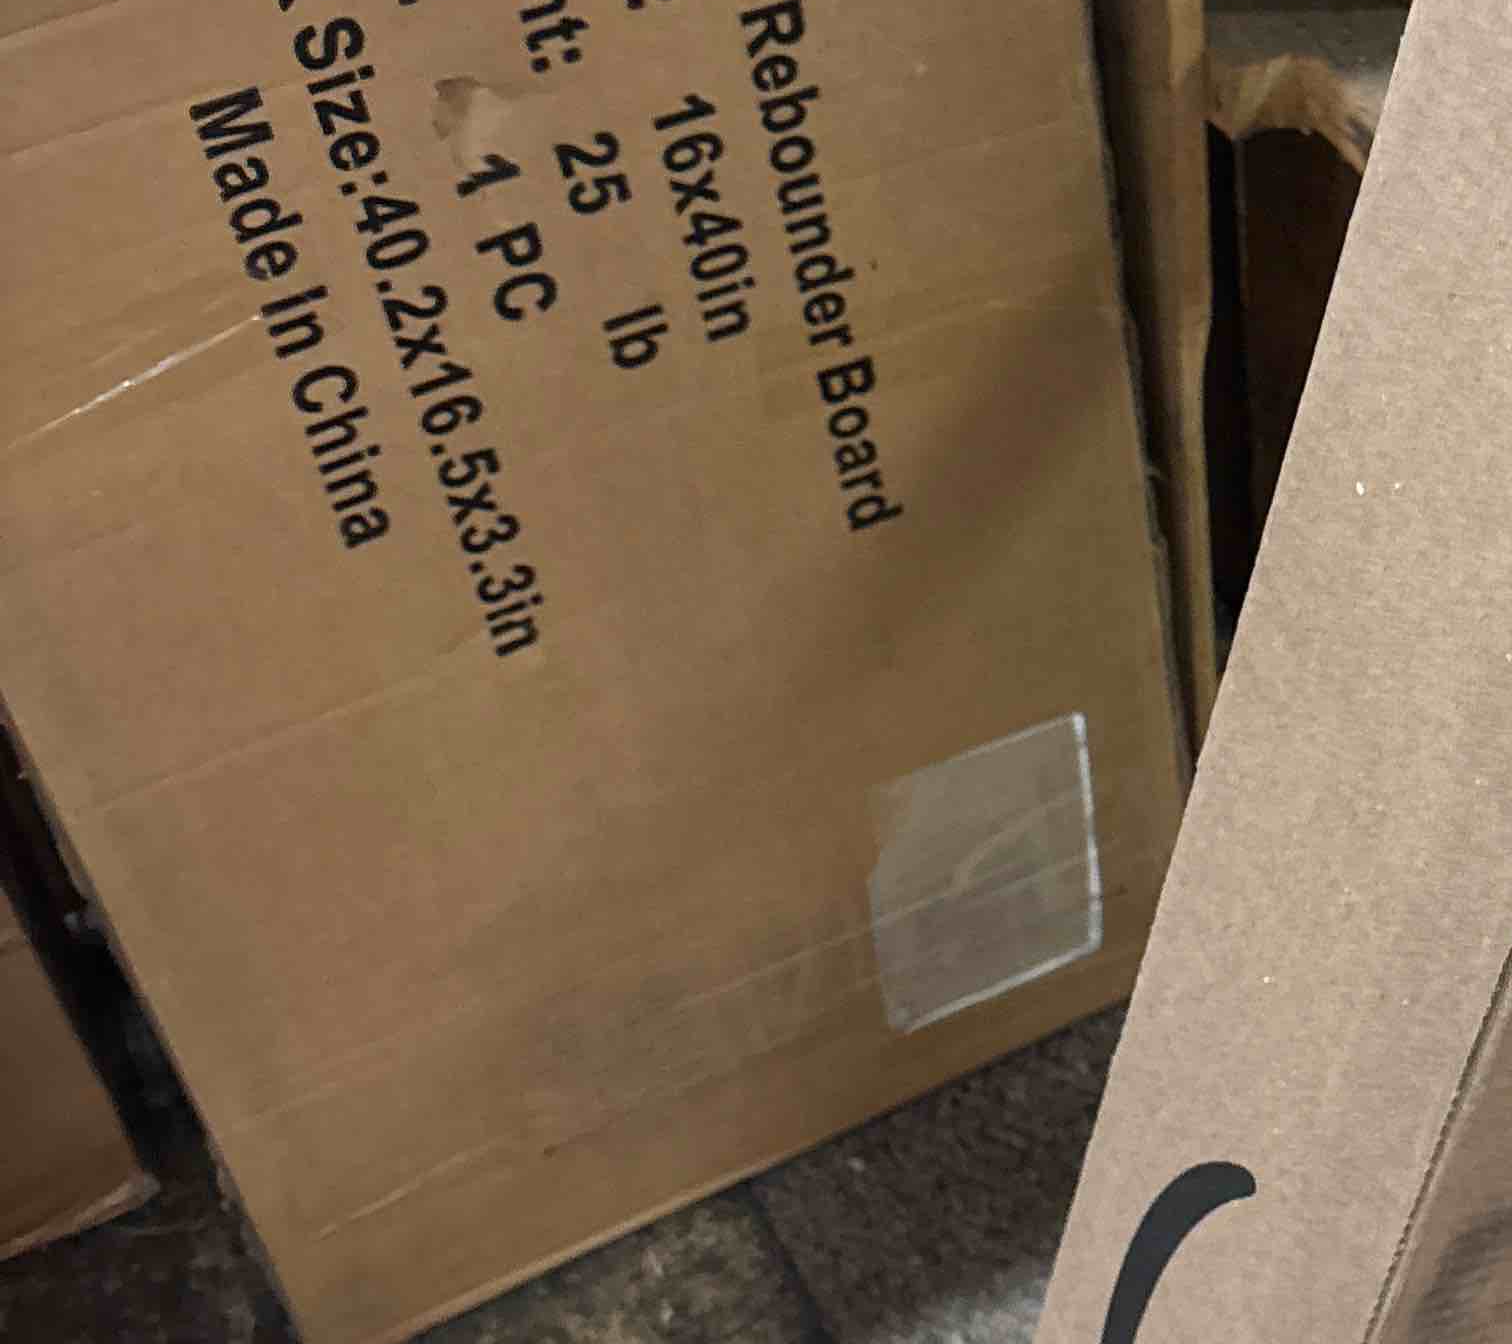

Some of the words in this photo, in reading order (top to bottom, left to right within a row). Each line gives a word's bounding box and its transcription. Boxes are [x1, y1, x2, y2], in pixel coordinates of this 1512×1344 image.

[188, 86, 303, 281] Made
[456, 153, 521, 198] 1
[553, 131, 633, 215] 25
[603, 303, 669, 369] lb
[653, 93, 756, 342] 16x40in
[260, 284, 329, 359] In
[475, 222, 558, 322] PC
[291, 365, 390, 549] China
[816, 355, 904, 532] Board
